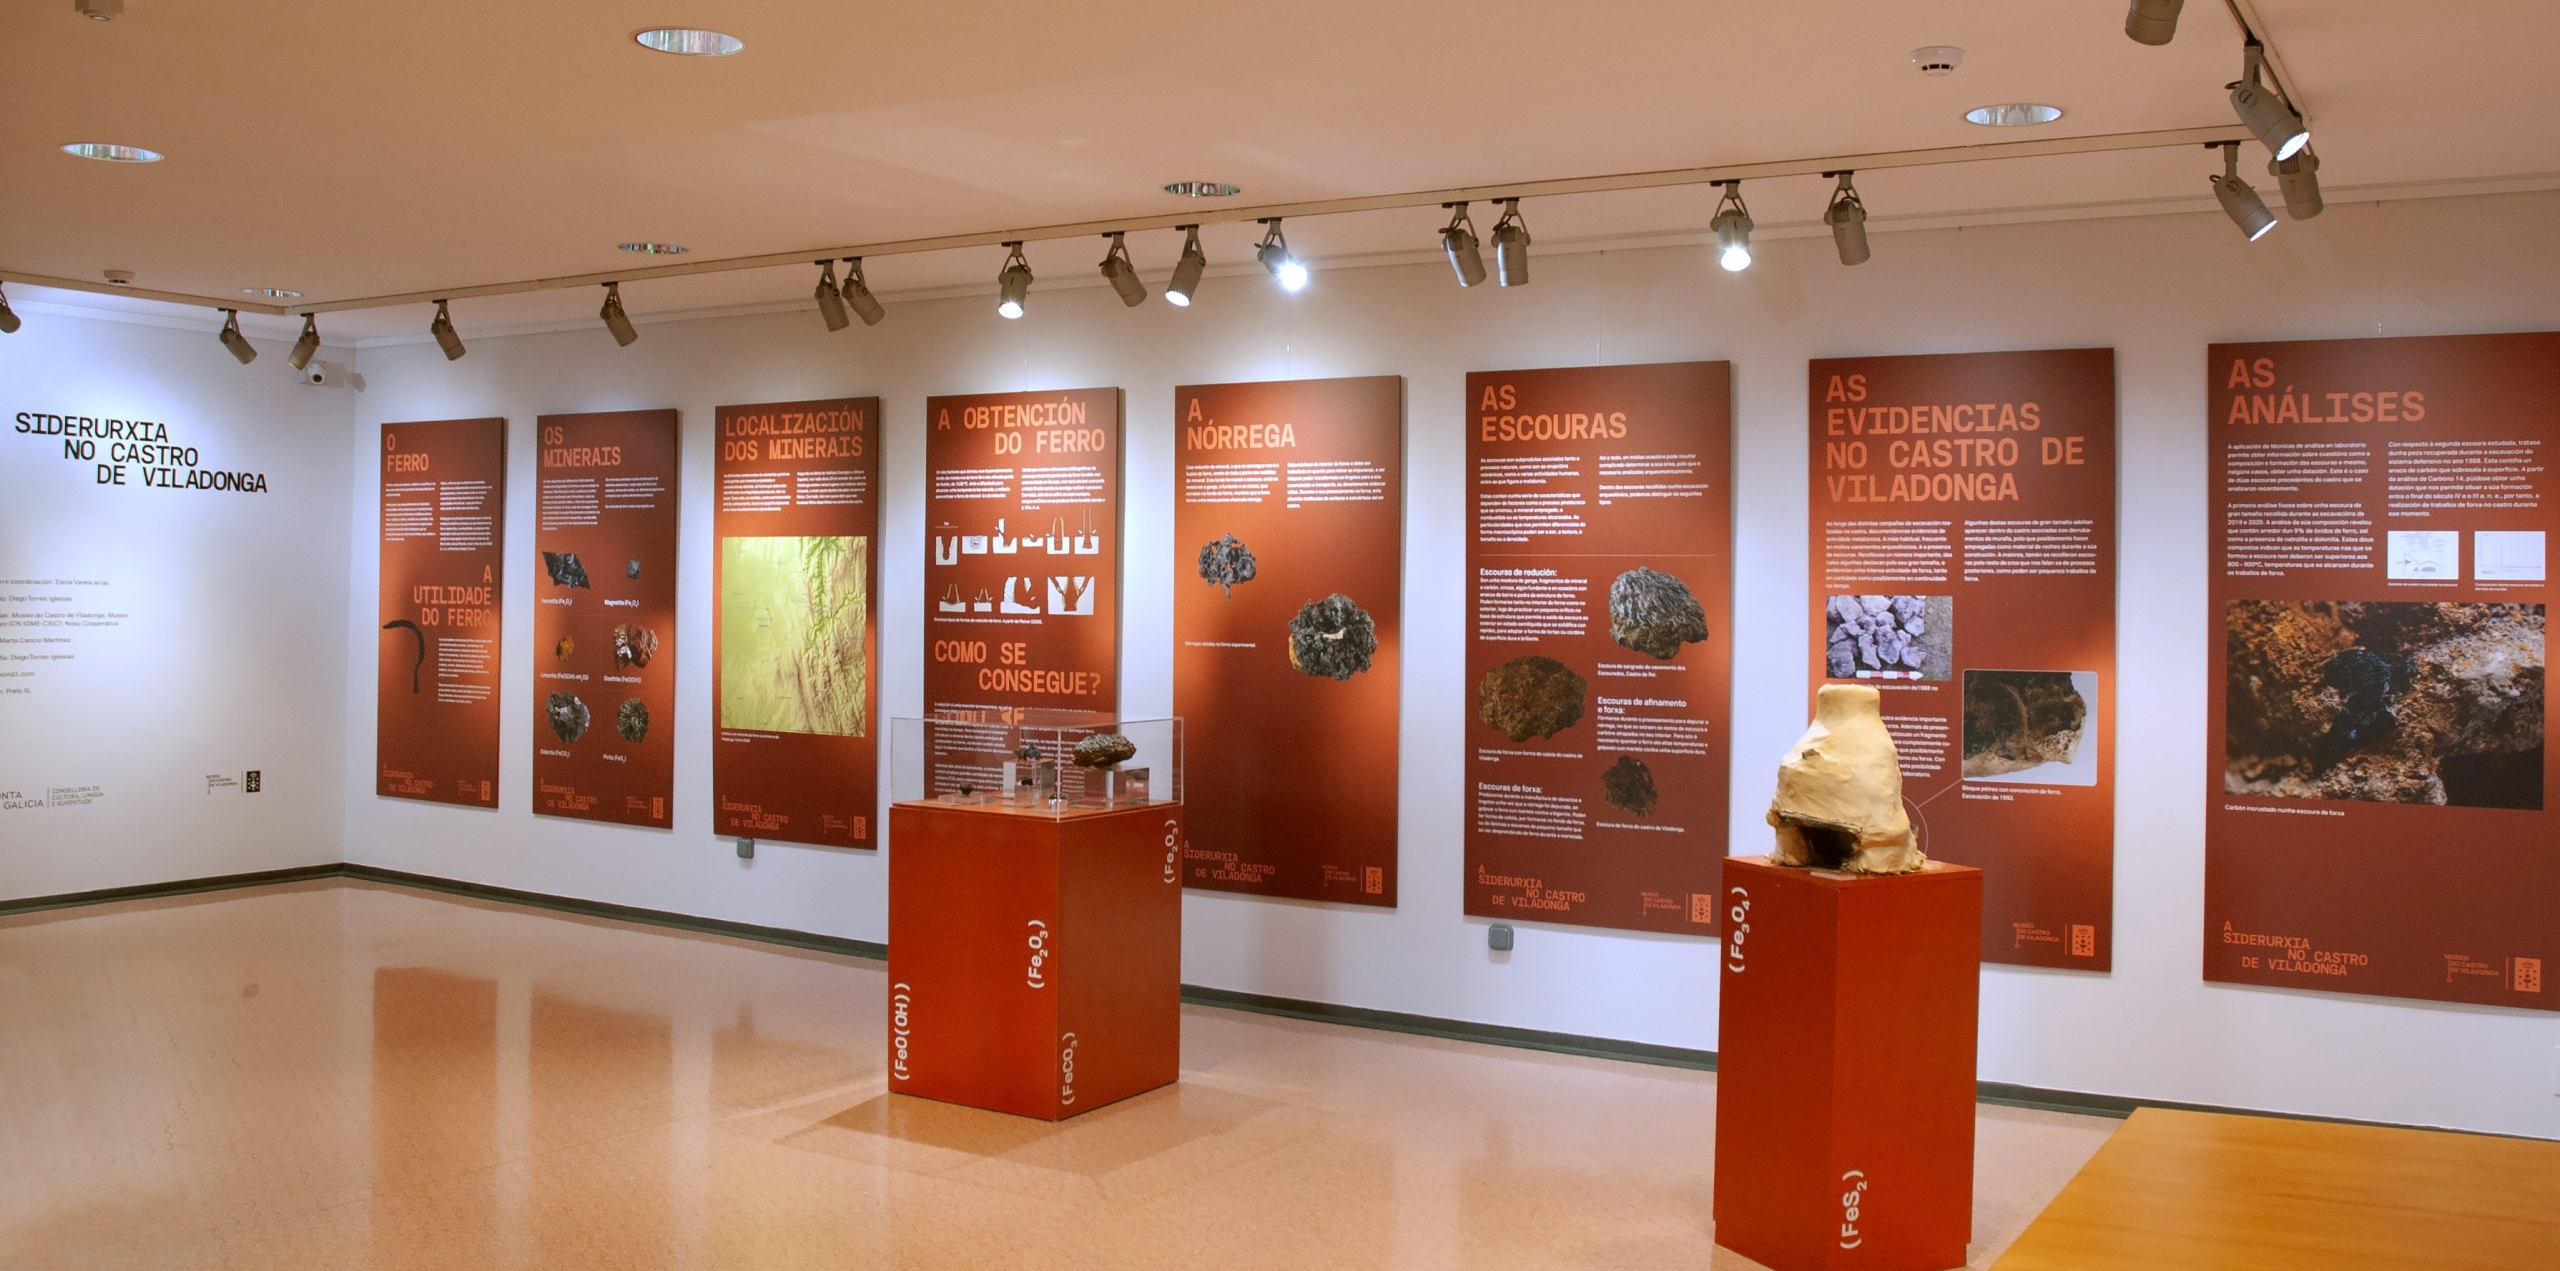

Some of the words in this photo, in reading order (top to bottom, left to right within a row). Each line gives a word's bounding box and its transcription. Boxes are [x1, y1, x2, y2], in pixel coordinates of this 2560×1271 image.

[2227, 357, 2276, 389] AS
[1480, 384, 1516, 412] AS
[1826, 374, 1867, 402] AS
[937, 408, 951, 430] A
[963, 395, 1086, 430] OBTENCIÓN
[1187, 398, 1203, 422] A
[2227, 385, 2426, 425] ANÁLISES
[15, 412, 168, 443] SIDERURXIA
[725, 404, 864, 437] LOCALIZACIÓN
[1481, 412, 1628, 442] ESCOURAS
[1827, 402, 2041, 436] EVIDENCIAS
[386, 433, 396, 452] O
[544, 426, 564, 445] OS
[994, 431, 1022, 455] DO
[1036, 428, 1106, 453] FERRO
[1187, 419, 1296, 450] NÓRREGA
[64, 439, 95, 460] NO
[111, 443, 198, 467] CASTRO
[543, 446, 621, 468] MINERAIS
[725, 440, 758, 462] DOS
[769, 435, 863, 460] MINERAIS
[1827, 441, 1868, 469] NO
[1889, 437, 2019, 468] CASTRO
[2042, 436, 2085, 466] DE
[387, 453, 429, 473] FERRO
[97, 464, 126, 485] DE
[142, 467, 267, 493] VILADONGA
[1827, 472, 2019, 503] VILADONGA
[483, 564, 493, 583] A
[1480, 568, 1513, 576] Escouras
[1513, 568, 1523, 576] de
[1523, 568, 1558, 577] redución:
[413, 586, 491, 605] UTILIDADE
[421, 607, 439, 626] DO
[448, 608, 492, 628] FERRO
[934, 640, 987, 663] COMO
[1000, 641, 1027, 665] SE
[979, 668, 1101, 695] CONSEGUE?
[1597, 696, 1632, 706] Escouras
[1633, 697, 1643, 706] de
[1644, 698, 1687, 708] afinamento
[1604, 706, 1625, 714] forxa:
[52, 785, 91, 794] CONSELLERÍA
[1478, 782, 1511, 792] Escouras
[1522, 785, 1543, 794] forxa:
[3, 799, 44, 810] GALICIA
[2246, 805, 2277, 813] incrustado
[1164, 819, 1179, 884] (Fe2O3)
[1184, 840, 1190, 849] A
[1184, 849, 1238, 863] SIDERURXIA
[1195, 868, 1207, 878] DE
[1212, 869, 1263, 883] VILADONGA
[1224, 862, 1236, 871] NO
[1240, 863, 1276, 875] CASTRO
[1478, 864, 1486, 874] A
[1478, 874, 1543, 889] SIDERURXIA
[1492, 895, 1505, 906] DE
[1511, 897, 1570, 911] VILADONGA
[1526, 889, 1539, 899] NO
[1545, 890, 1586, 903] CASTRO
[1728, 885, 1750, 973] (Fe3O4)
[2223, 921, 2232, 932] A
[2223, 932, 2310, 950] SIDERURXIA
[1027, 919, 1048, 989] (Fe2O3)
[2287, 949, 2306, 961] NO
[2314, 951, 2369, 966] CASTRO
[2242, 956, 2259, 969] DE
[2268, 958, 2348, 976] VILADONGA
[2460, 967, 2500, 976] VILADONGA
[894, 982, 910, 1081] (FeO(OH))
[1061, 1032, 1078, 1105] (FeCO3)
[1840, 1169, 1867, 1250] (FeS2)
